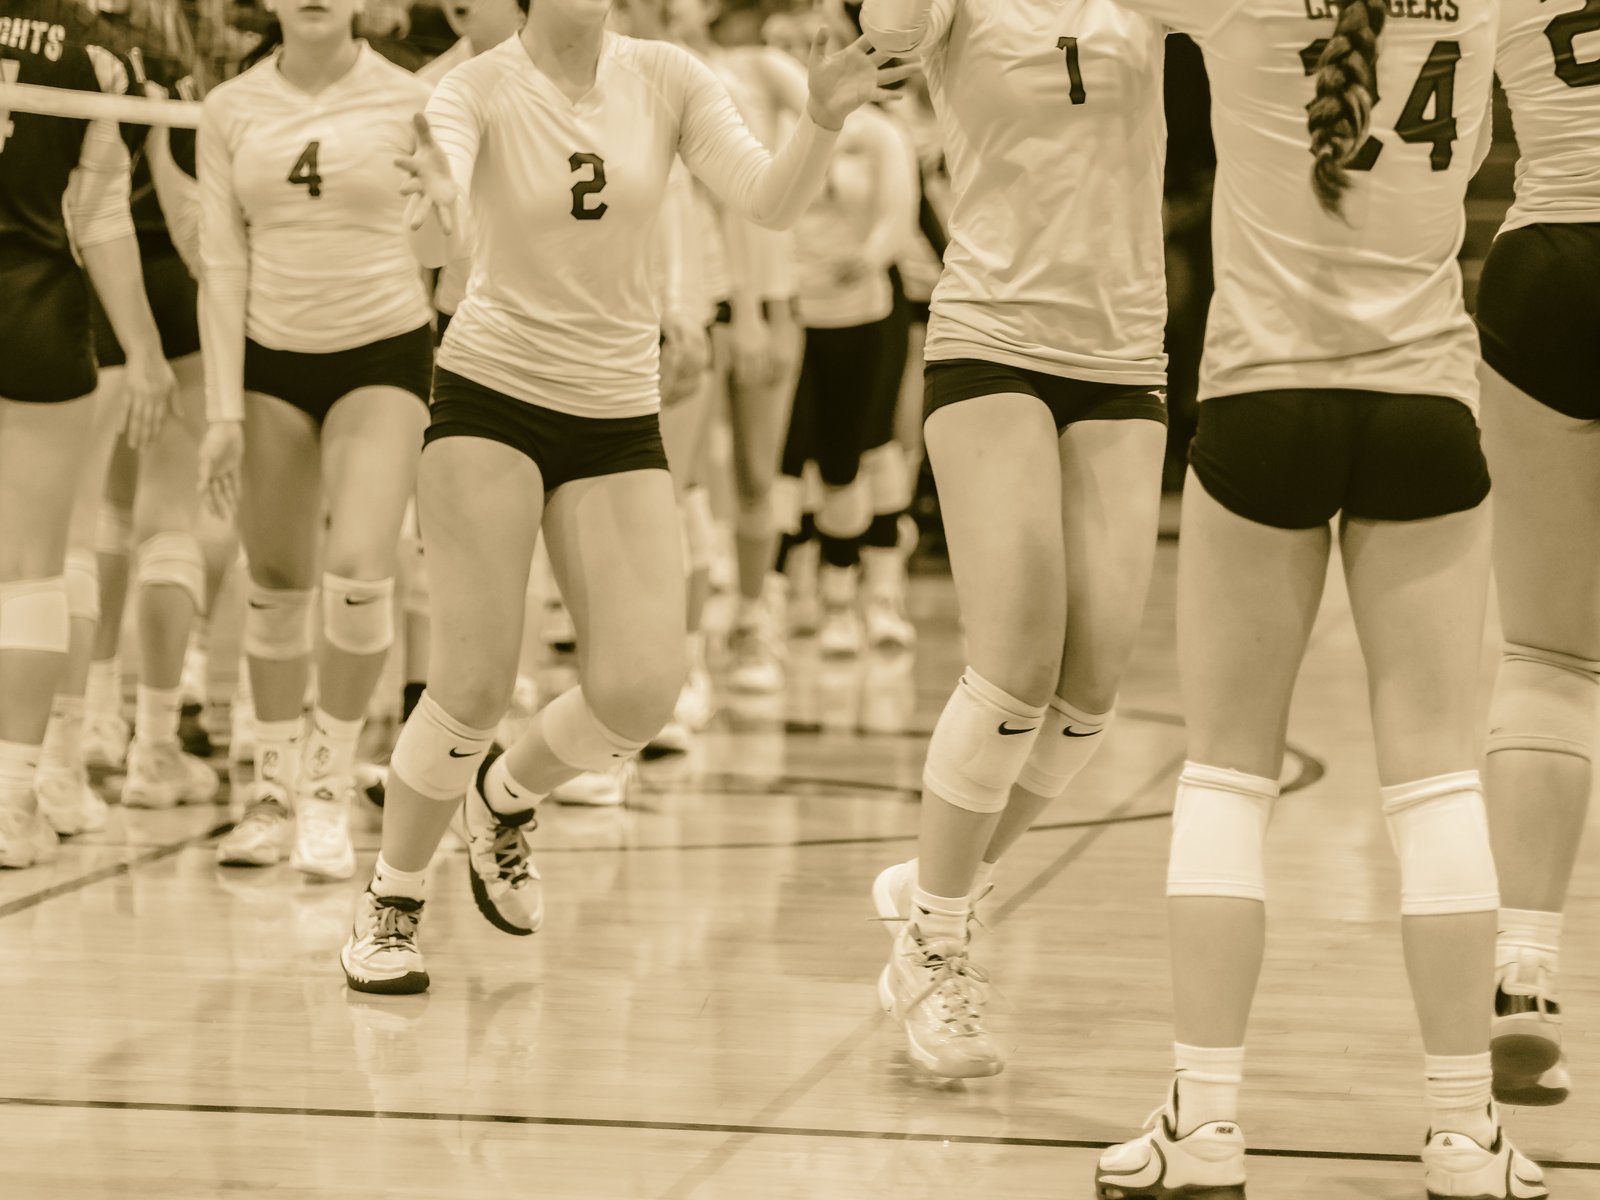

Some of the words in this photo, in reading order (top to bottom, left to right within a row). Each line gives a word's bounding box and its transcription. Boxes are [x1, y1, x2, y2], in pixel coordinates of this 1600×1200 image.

[1056, 36, 1086, 104] 1
[288, 141, 322, 198] 4
[568, 152, 608, 220] 2
